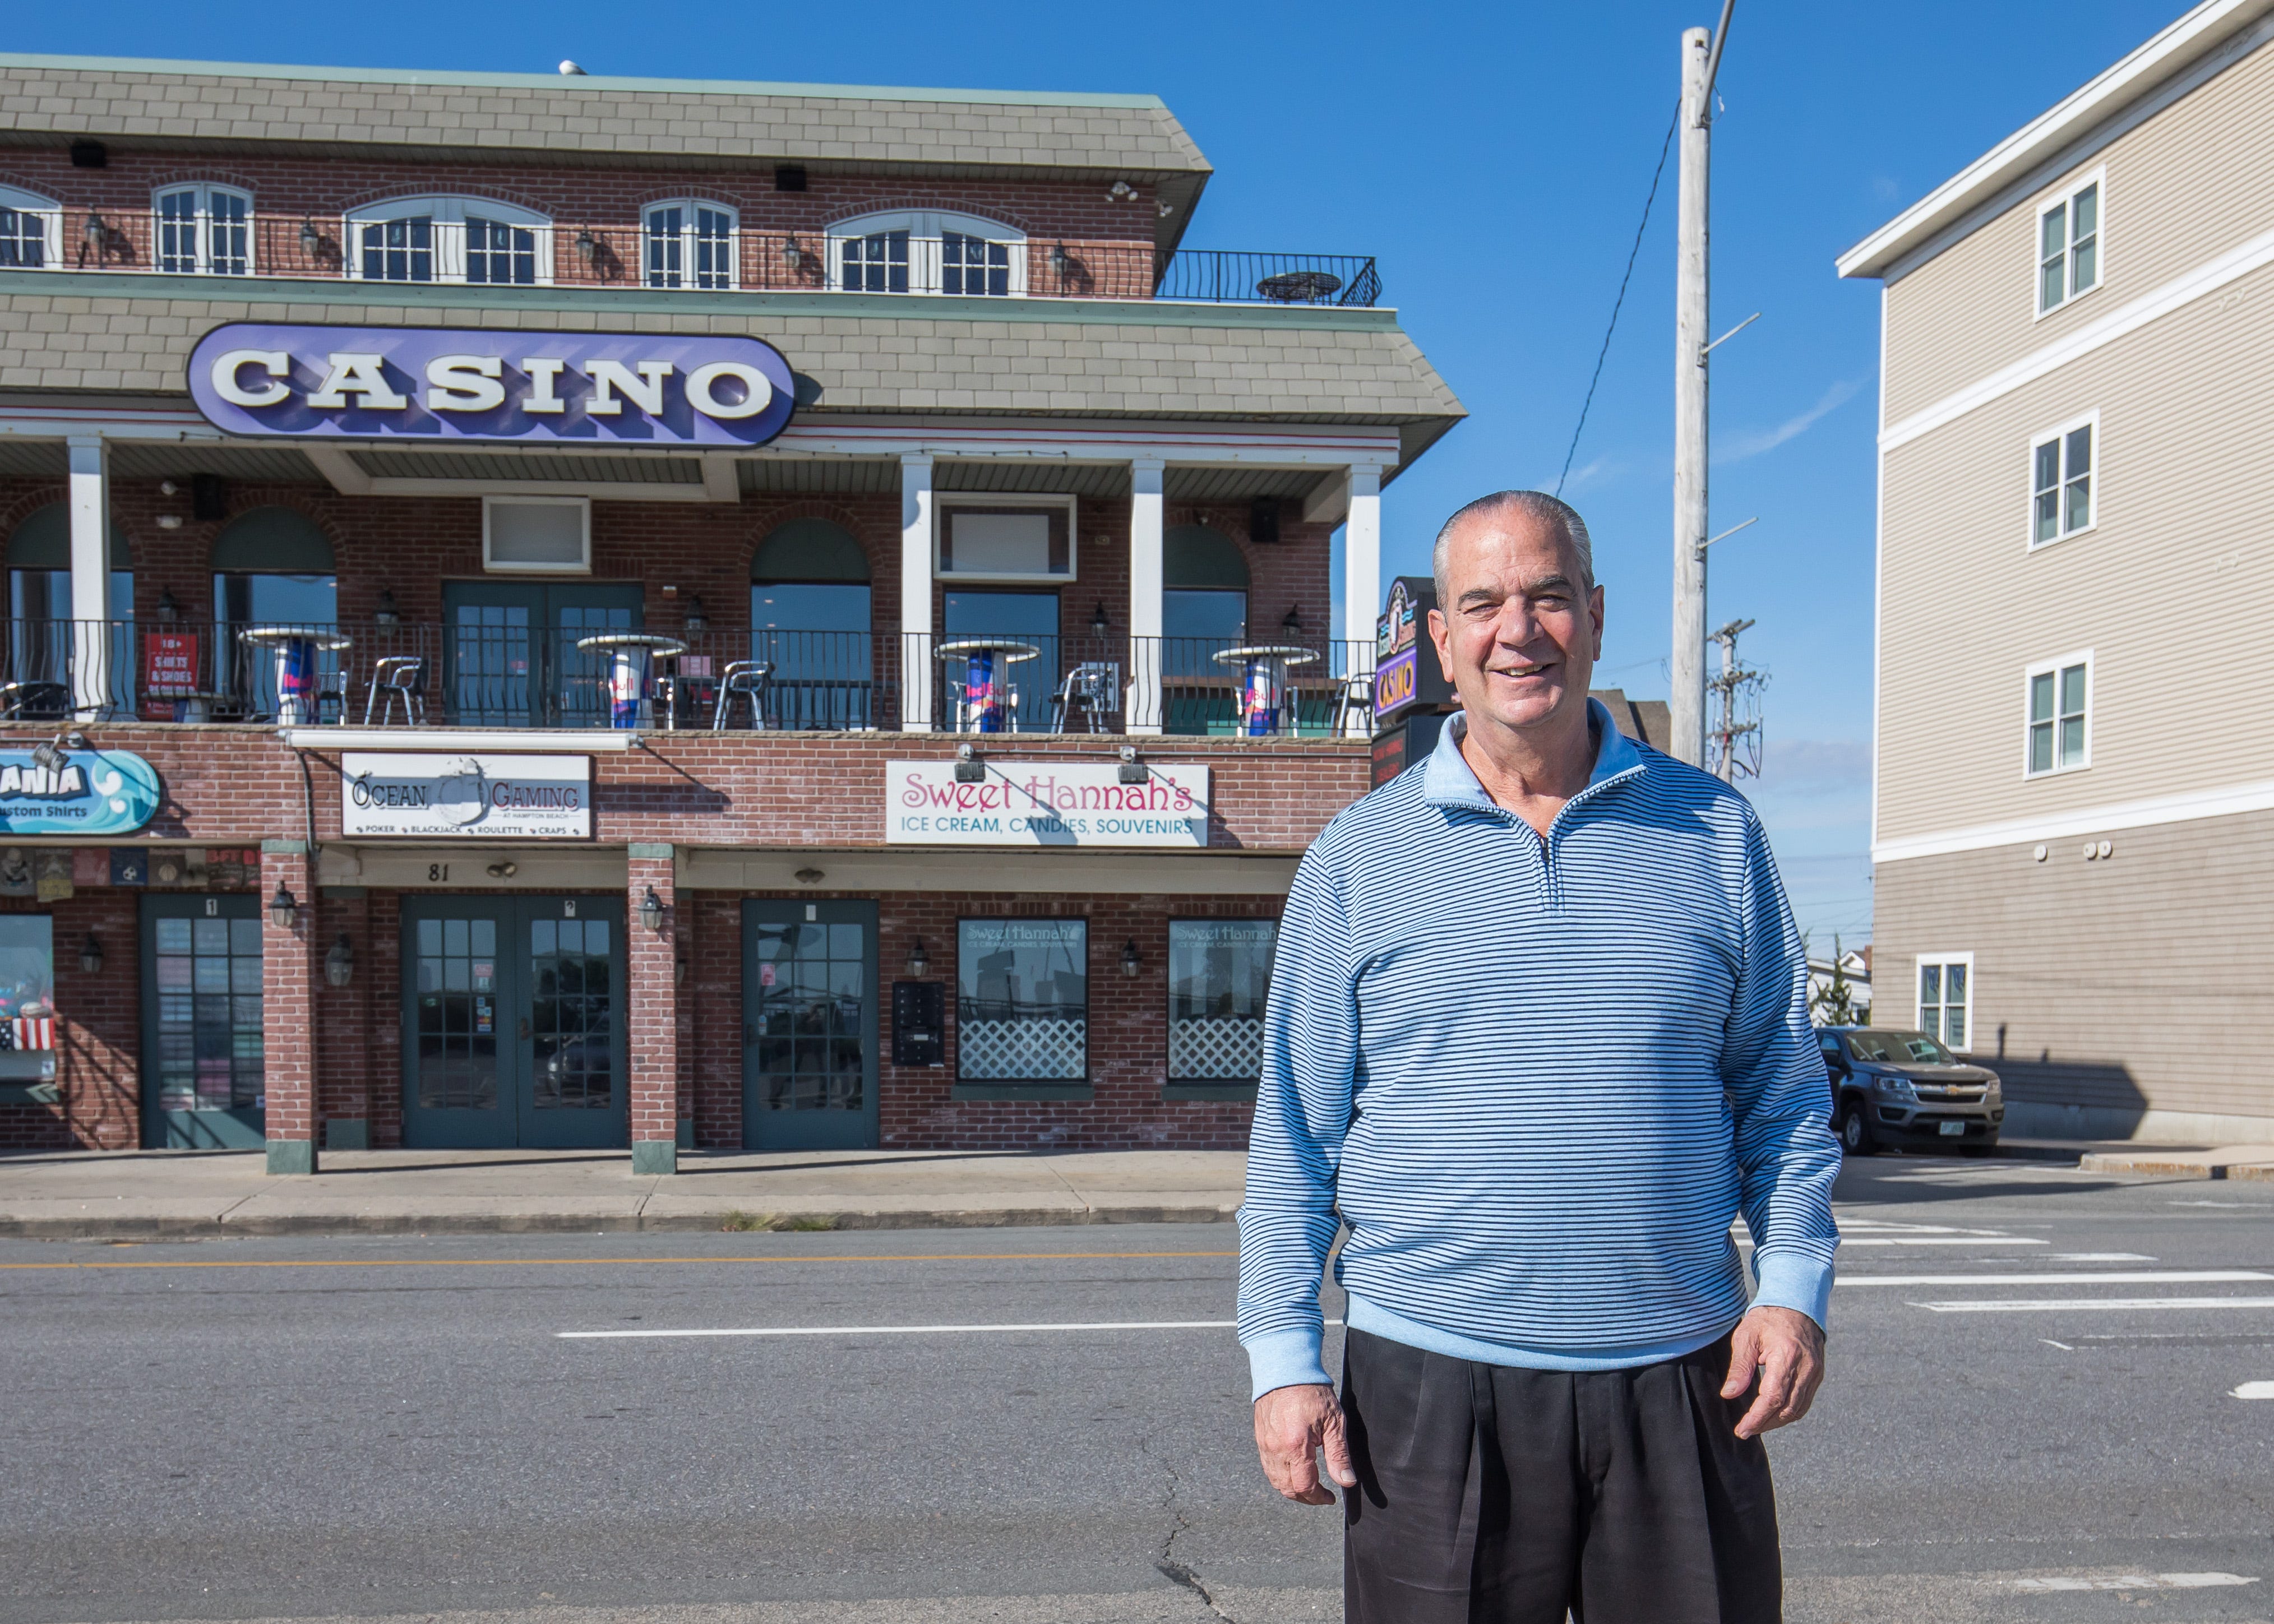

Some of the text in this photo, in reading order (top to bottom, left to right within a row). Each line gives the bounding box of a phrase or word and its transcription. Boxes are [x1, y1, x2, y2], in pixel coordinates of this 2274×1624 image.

[210, 349, 773, 418] CASINO
[161, 670, 192, 682] SHOES
[1378, 659, 1414, 709] CASINO
[352, 779, 579, 809] OCEAN GAMING
[902, 773, 1194, 812] Sweet Hannah's
[46, 806, 87, 817] Shirts
[902, 817, 1193, 835] ICE CREAM, CANDIES, SOUVENIRS
[428, 863, 449, 882] 81
[967, 926, 1009, 941] Sweet
[1178, 926, 1219, 941] Sweet
